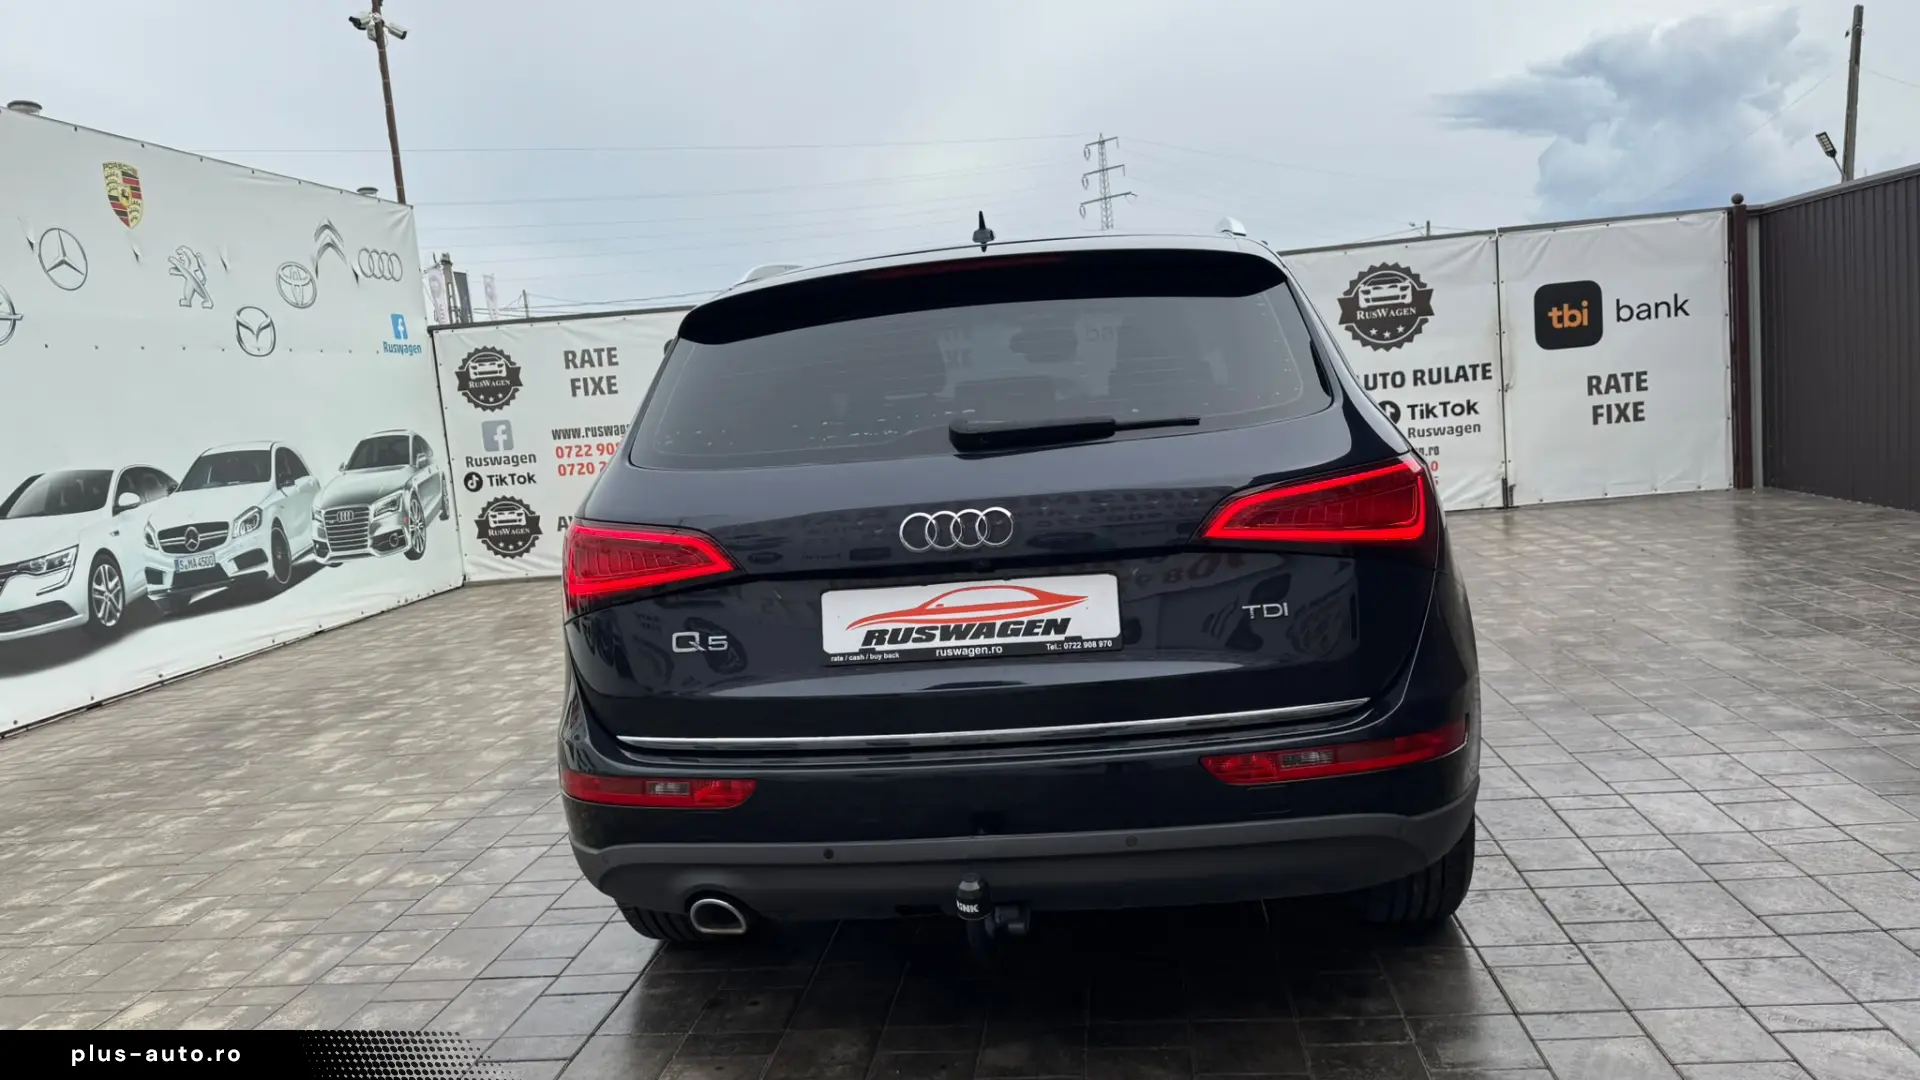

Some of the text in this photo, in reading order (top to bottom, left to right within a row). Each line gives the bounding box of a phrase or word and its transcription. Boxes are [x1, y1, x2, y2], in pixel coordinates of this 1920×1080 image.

[1548, 293, 1690, 329] tbi bank
[383, 341, 422, 356] Ruswagen
[563, 347, 619, 370] RATE
[1356, 362, 1493, 391] UTO RULATE
[1587, 370, 1648, 396] RATE
[570, 375, 619, 397] FIXE
[1407, 399, 1480, 421] TikTok
[1592, 401, 1645, 425] FIXE
[551, 424, 631, 441] www.ruswag
[1407, 423, 1481, 438] Ruswagen
[555, 444, 593, 459] 0722
[465, 453, 537, 468] Ruswagen
[557, 462, 595, 477] 0720
[486, 471, 537, 488] TikTok
[1242, 602, 1289, 619] TDI
[861, 617, 1072, 647] RUSWAGEN
[935, 646, 1003, 657] ruswagen.ro
[1098, 640, 1113, 648] 970
[870, 653, 882, 661] buy
